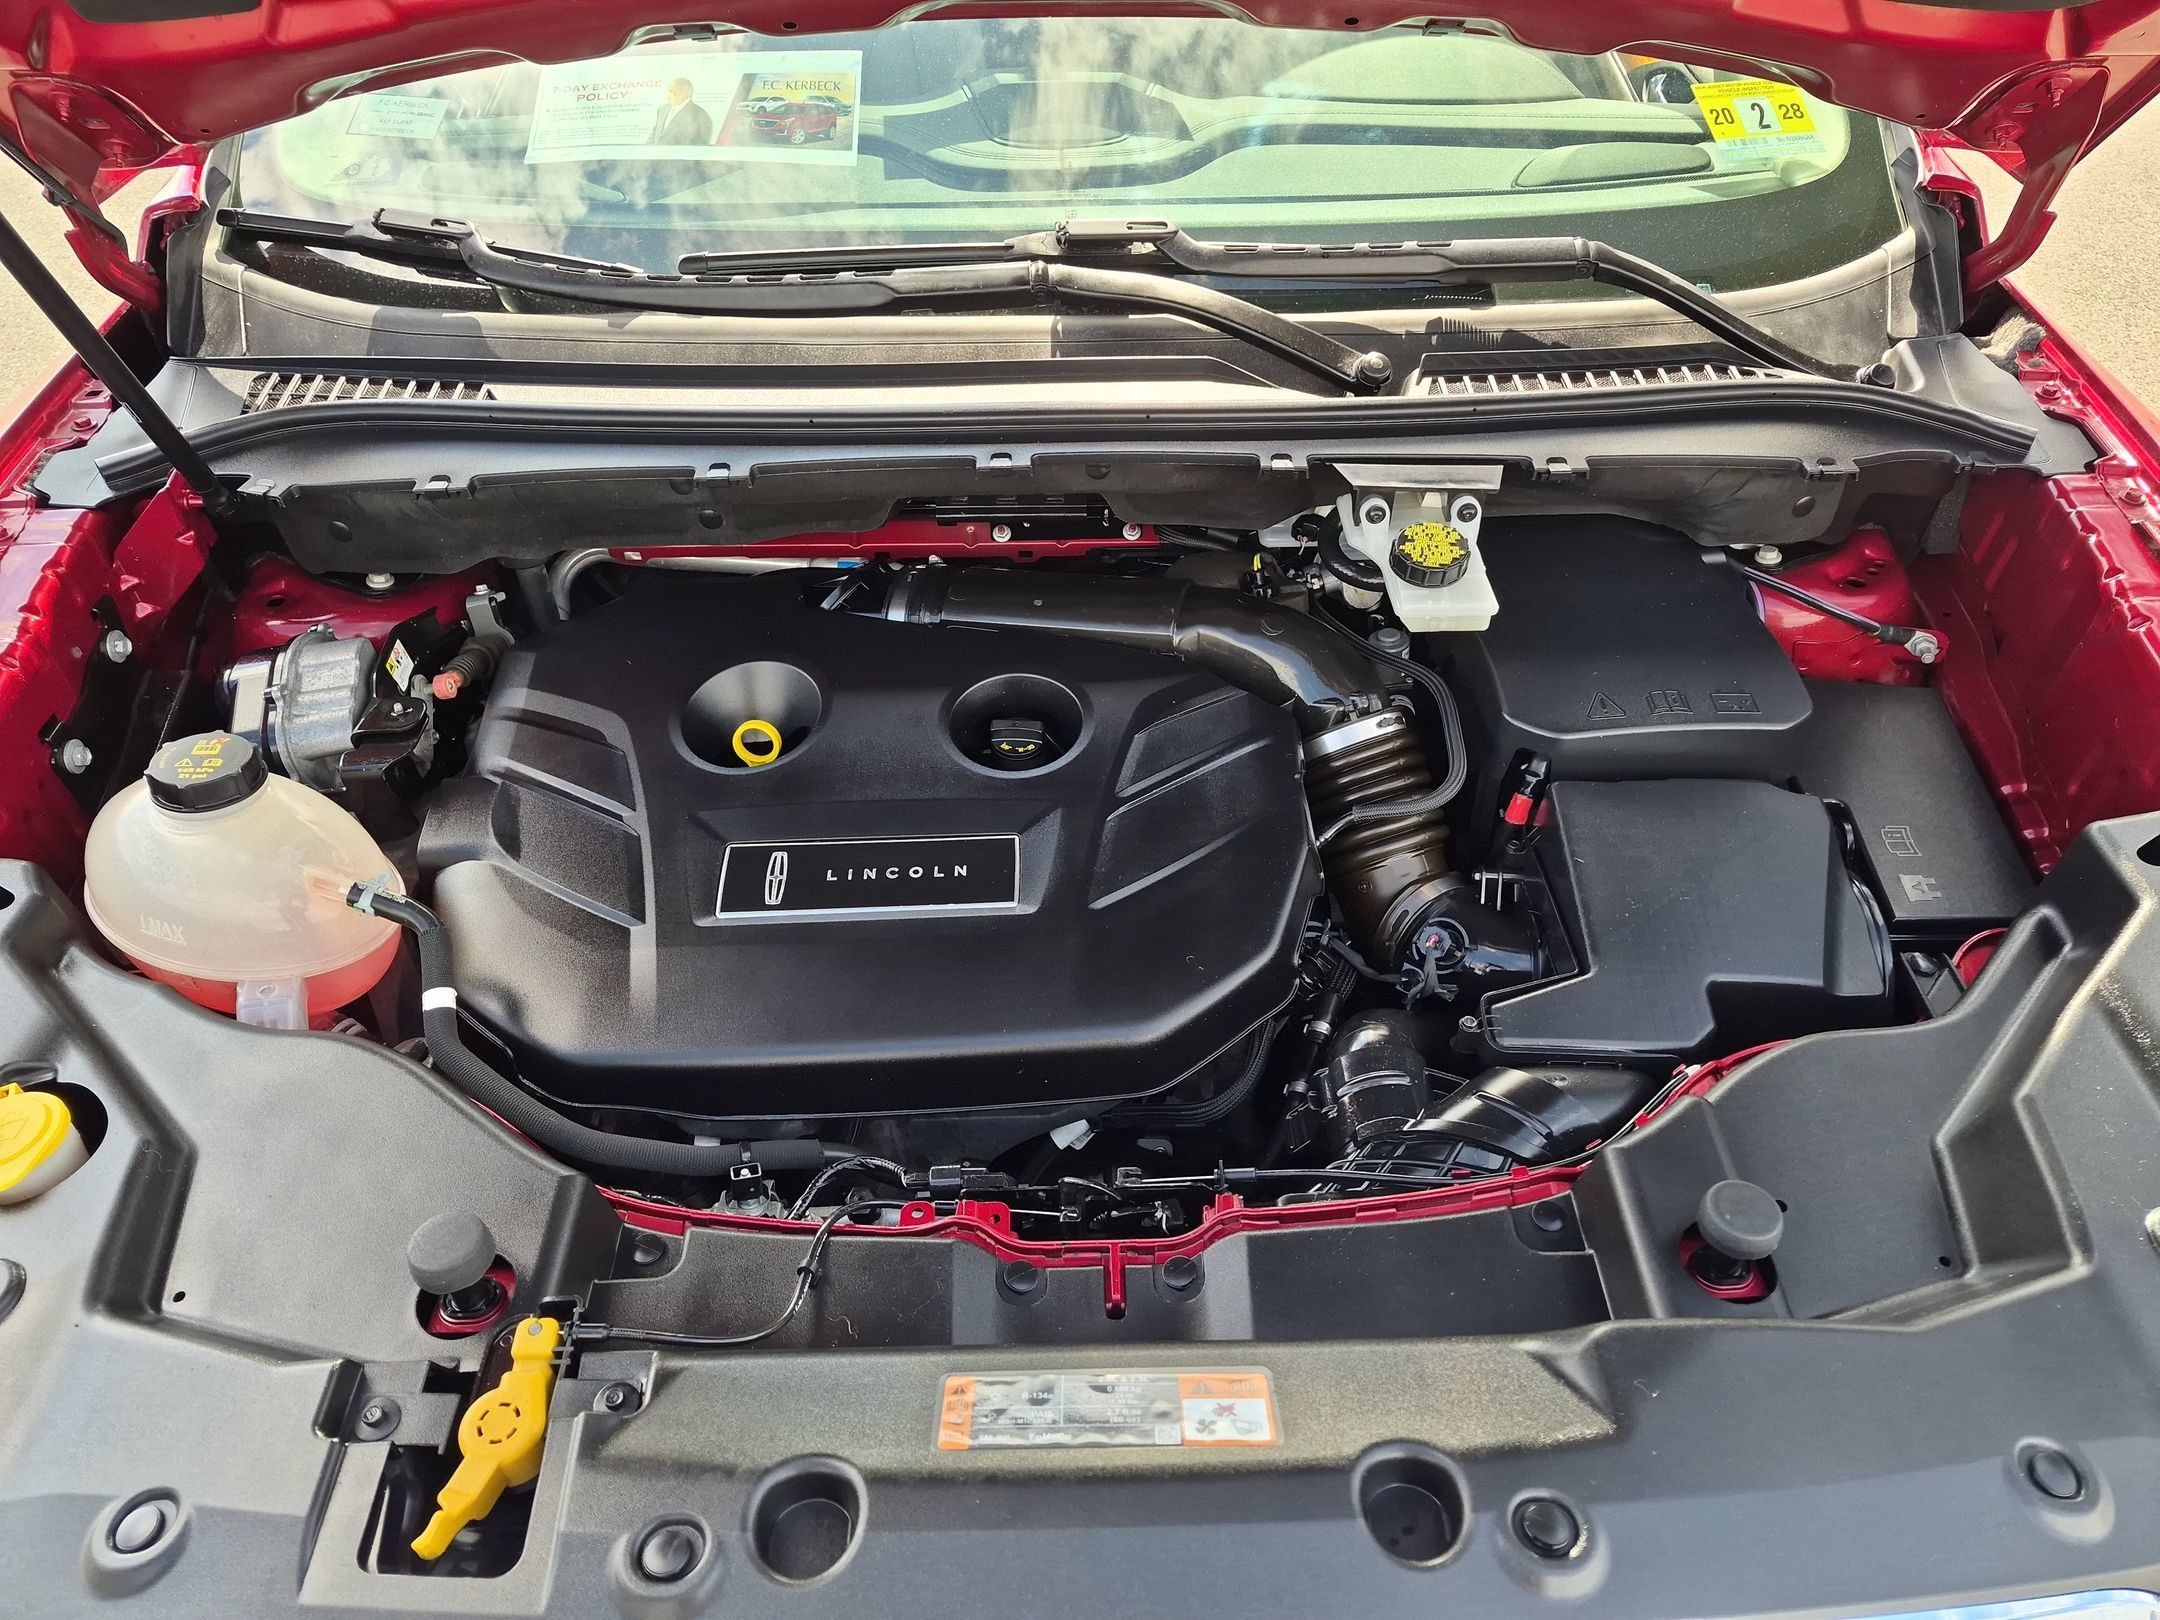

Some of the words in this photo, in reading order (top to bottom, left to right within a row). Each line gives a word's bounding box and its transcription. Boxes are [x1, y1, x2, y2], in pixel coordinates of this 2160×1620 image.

[552, 83, 589, 94] 7-DAY
[592, 80, 664, 92] EXCHANGE
[762, 80, 783, 91] F.C.
[785, 80, 842, 91] KERBECK
[1709, 107, 1735, 126] 20
[1750, 102, 1772, 130] 2
[1778, 103, 1805, 120] 28
[826, 865, 968, 882] LINCOLN
[1021, 1391, 1053, 1400] R-134a
